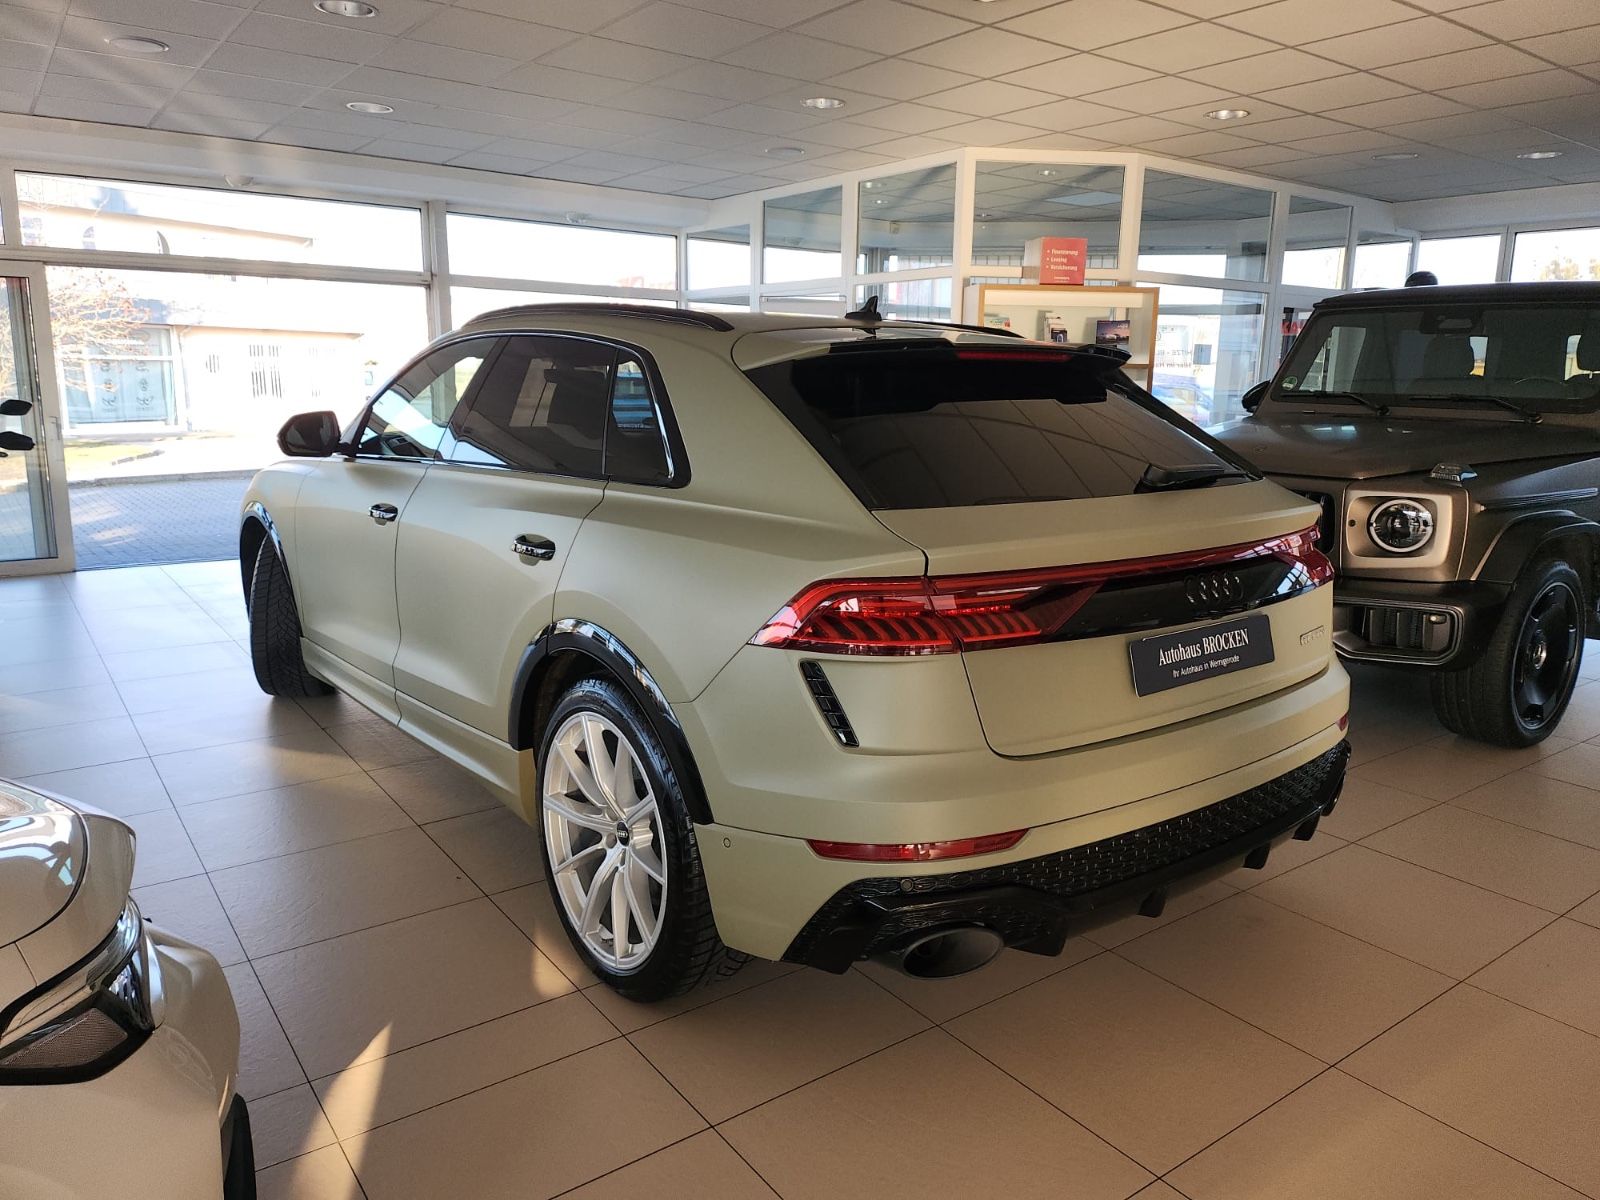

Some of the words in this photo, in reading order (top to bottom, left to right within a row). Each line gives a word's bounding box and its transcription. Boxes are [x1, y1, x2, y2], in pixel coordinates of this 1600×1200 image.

[1158, 643, 1202, 667] Autohaus
[1202, 628, 1249, 655] BROCKEN
[1172, 669, 1180, 678] Ihr
[1180, 664, 1204, 676] Autohaus
[1203, 661, 1210, 670] in
